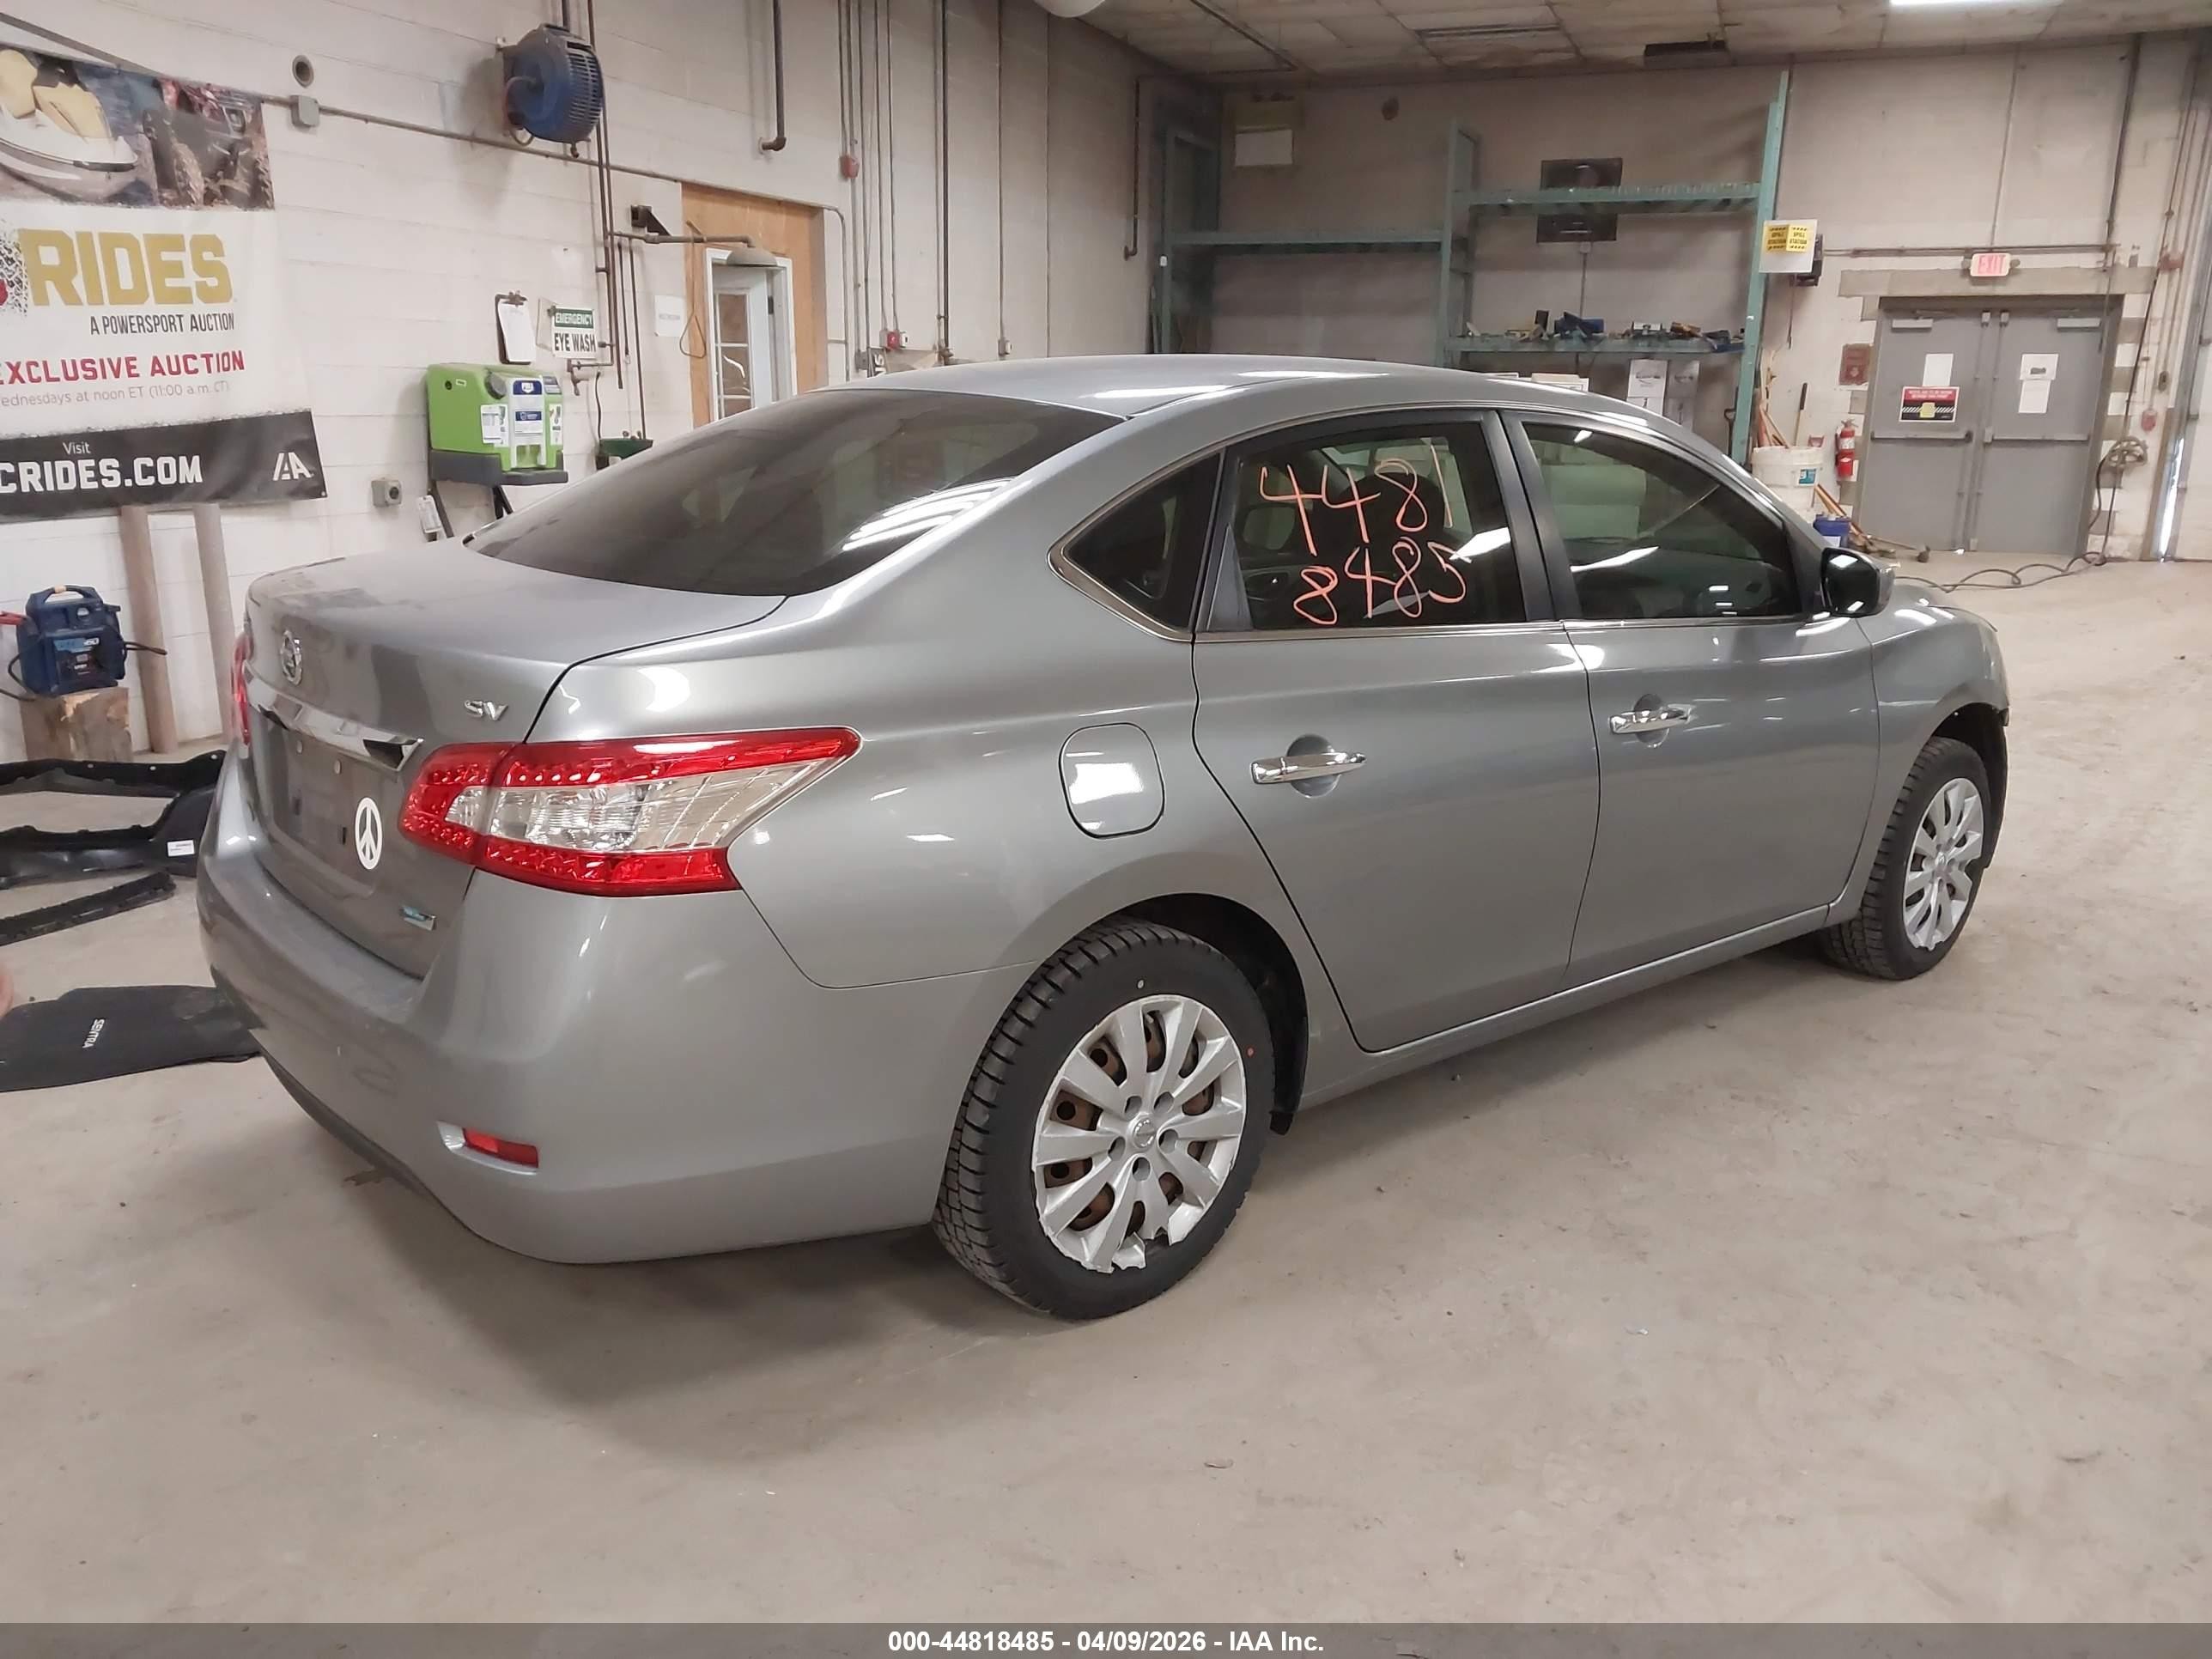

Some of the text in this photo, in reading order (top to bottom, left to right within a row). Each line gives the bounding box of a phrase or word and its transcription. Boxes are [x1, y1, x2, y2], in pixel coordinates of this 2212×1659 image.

[17, 228, 233, 306] RIDES
[1978, 254, 2006, 274] EXIT
[90, 313, 234, 336] A POWERSPORT AUCTION
[555, 312, 592, 325] EMERGENCY
[554, 332, 597, 352] EYE WASH
[150, 350, 245, 378] AUCTION
[0, 390, 72, 407] ednesdays
[76, 391, 89, 402] at
[94, 389, 125, 400] noon
[129, 386, 144, 398] ET
[63, 441, 91, 455] Visit
[464, 699, 508, 721] SV
